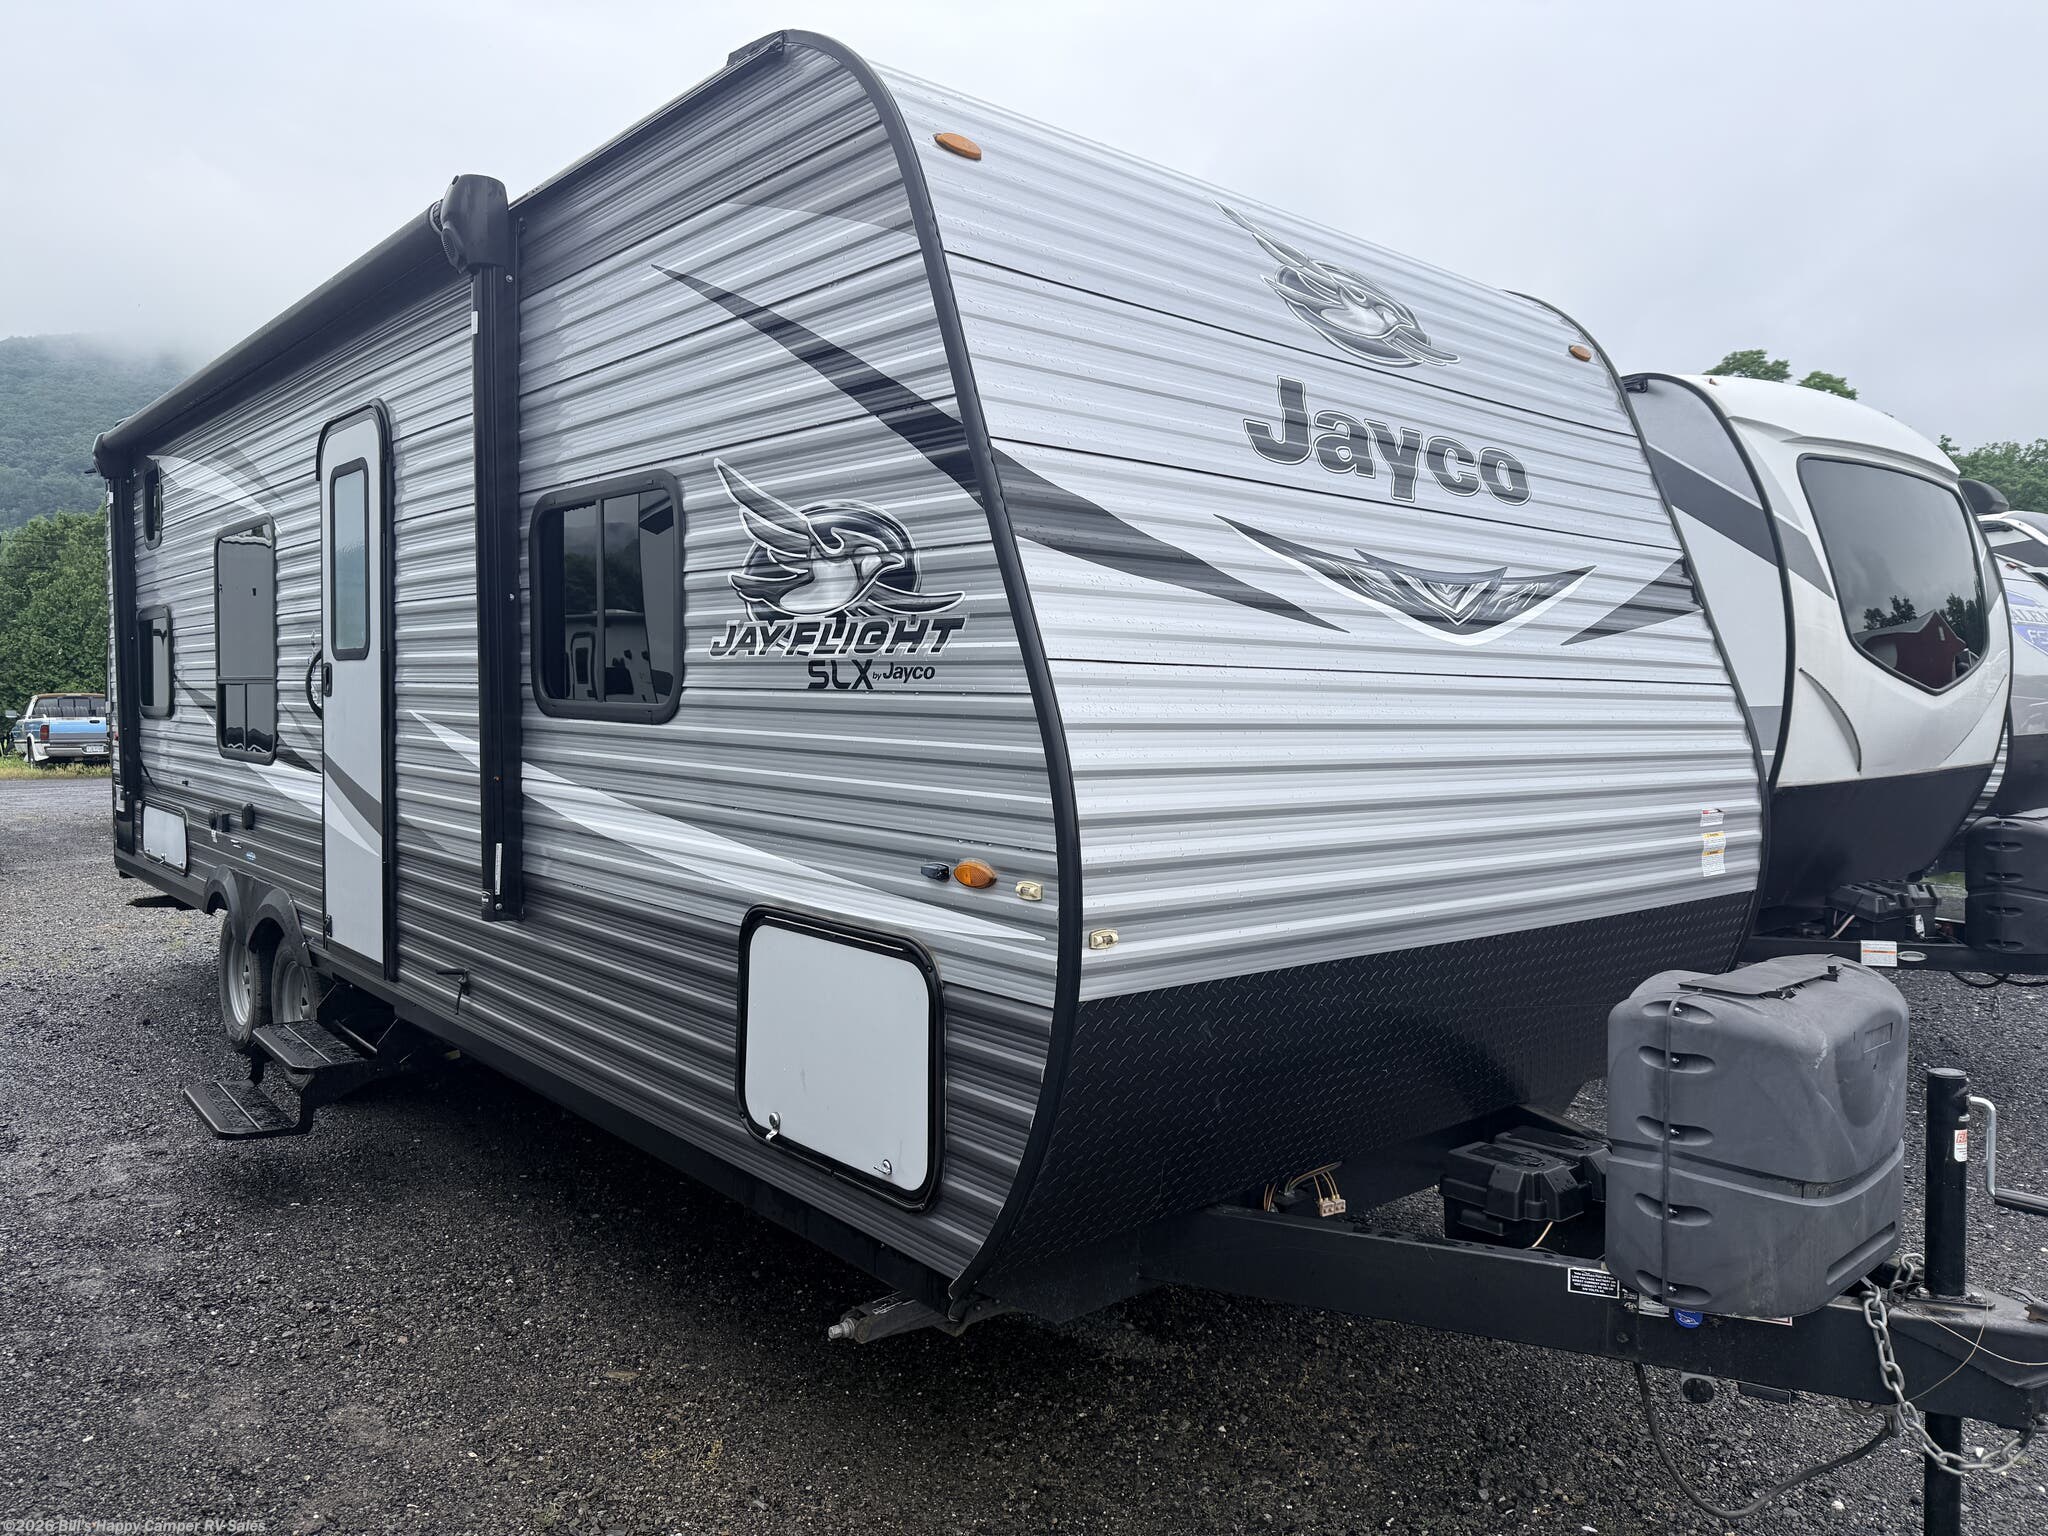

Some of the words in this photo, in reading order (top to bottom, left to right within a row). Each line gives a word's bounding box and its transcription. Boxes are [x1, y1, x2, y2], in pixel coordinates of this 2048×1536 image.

[1243, 374, 1532, 506] Jayco
[807, 659, 874, 690] SLX
[872, 671, 882, 681] by
[883, 663, 936, 684] Jayco
